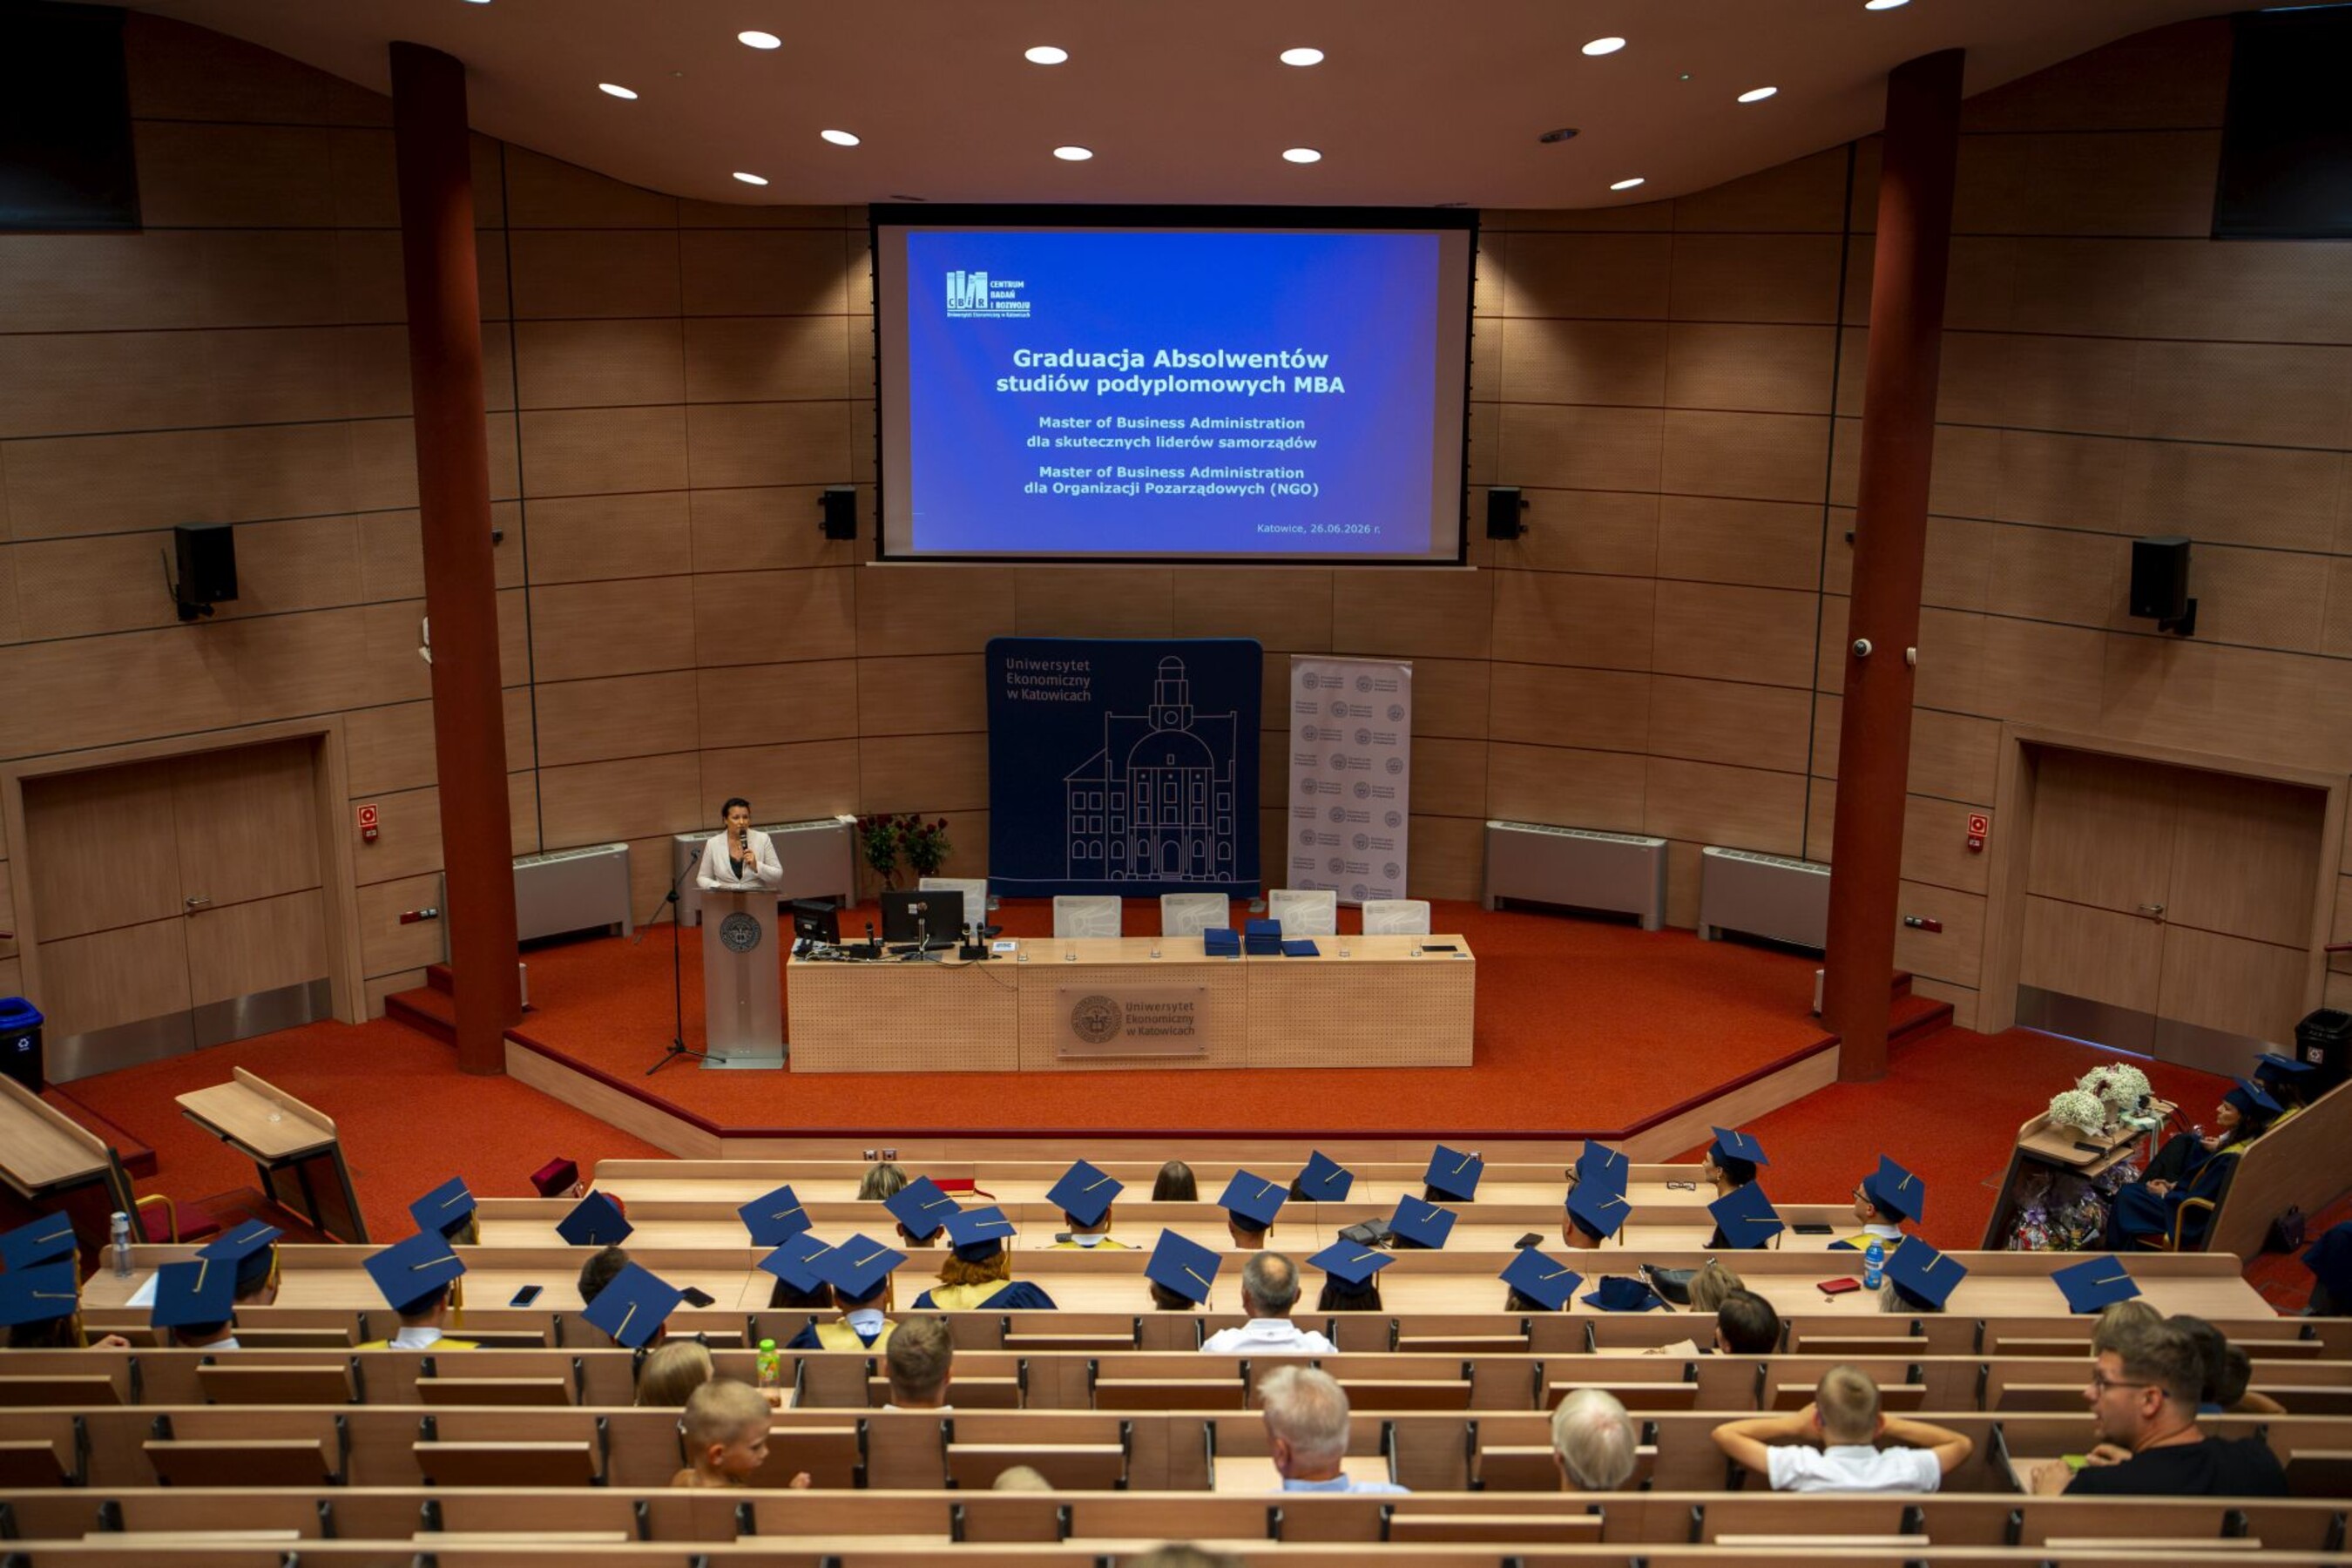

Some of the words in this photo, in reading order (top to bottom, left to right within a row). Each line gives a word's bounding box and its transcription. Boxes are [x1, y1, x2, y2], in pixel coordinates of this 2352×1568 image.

[990, 289, 1016, 299] BADAŃ
[1013, 348, 1145, 372] Graduacja
[1153, 348, 1329, 368] Absolwentów
[997, 374, 1089, 392] studiów
[1097, 375, 1286, 396] podyplomowych
[1294, 375, 1346, 394] MBA
[1039, 416, 1092, 429] Master
[1096, 416, 1112, 429] of
[1117, 416, 1186, 429] Business
[1189, 416, 1305, 429] Administration
[1026, 435, 1051, 448] dla
[1055, 436, 1151, 450] skutecznych
[1156, 435, 1214, 448] liderów
[1219, 436, 1317, 451] samorządów
[1039, 466, 1092, 478] Master
[1096, 465, 1113, 478] of
[1117, 466, 1186, 478] Business
[1189, 466, 1305, 479] Administration
[1024, 481, 1048, 494] dla
[1052, 482, 1140, 497] Organizacji
[1145, 482, 1265, 497] Pozarządowych
[1270, 483, 1319, 497] (NGO)
[1257, 524, 1307, 535] Katowice,
[1310, 524, 1371, 534] 26.06.2026
[1374, 525, 1381, 534] r.
[1006, 658, 1091, 673] Uniwersytet
[1006, 672, 1091, 688] Ekonomiczny
[1007, 690, 1018, 700] w
[1022, 688, 1092, 701] Katowicach
[1125, 1003, 1194, 1013] Uniwersytet
[1125, 1014, 1194, 1024] Ekonomiczny
[1138, 1026, 1195, 1036] Katowicach
